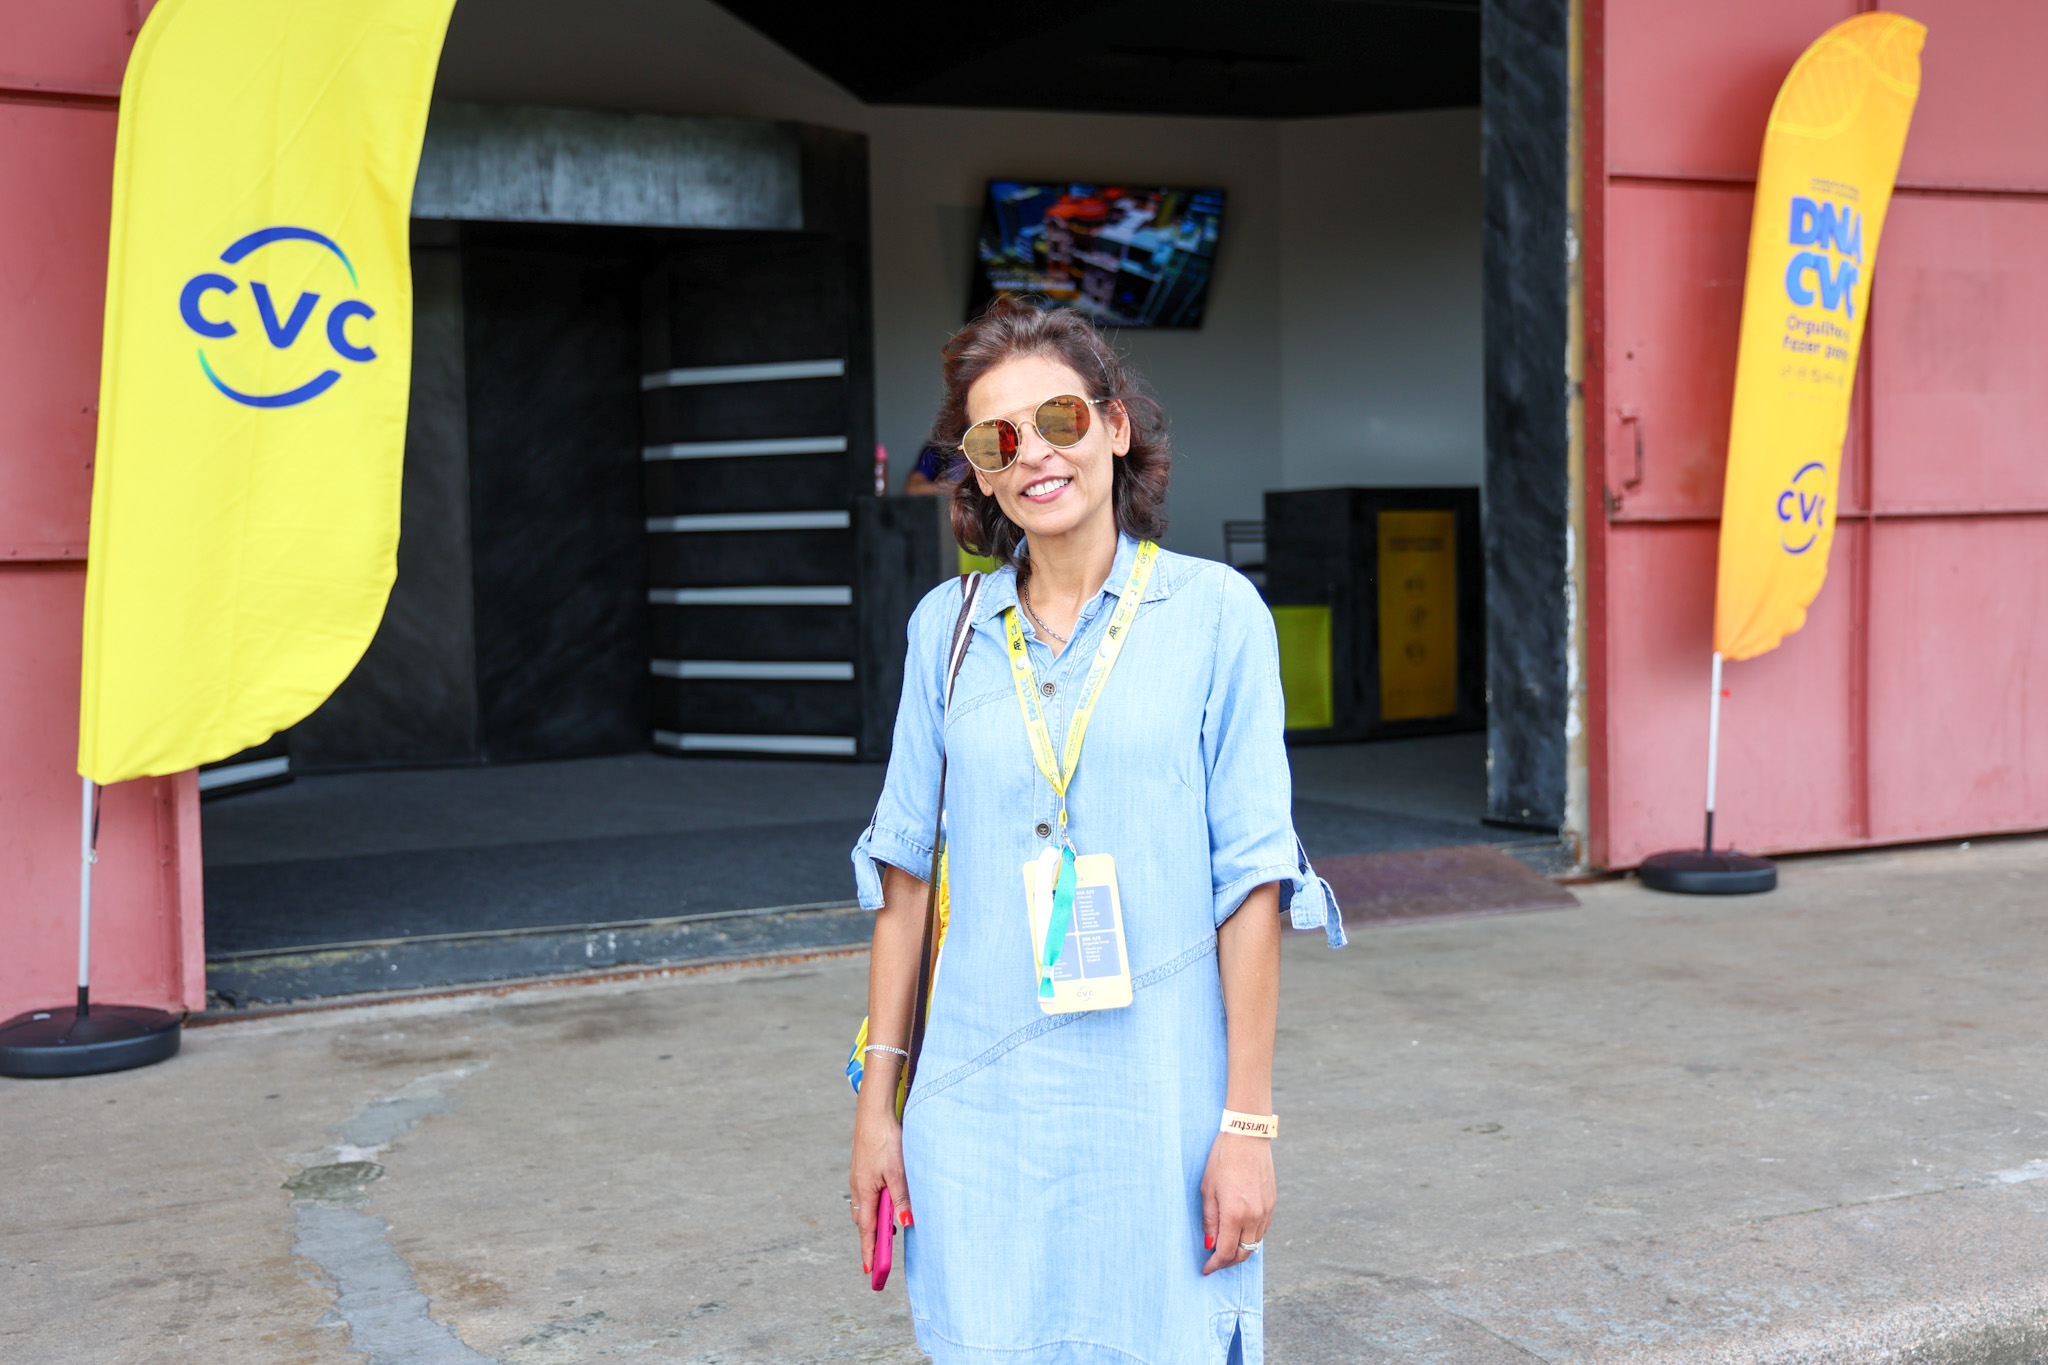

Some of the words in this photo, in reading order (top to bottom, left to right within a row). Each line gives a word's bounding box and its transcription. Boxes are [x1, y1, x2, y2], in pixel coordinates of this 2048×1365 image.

[1788, 196, 1863, 264] DNA
[179, 273, 378, 362] CVC
[1784, 251, 1859, 320] CVC
[1228, 1119, 1269, 1135] Turistur
